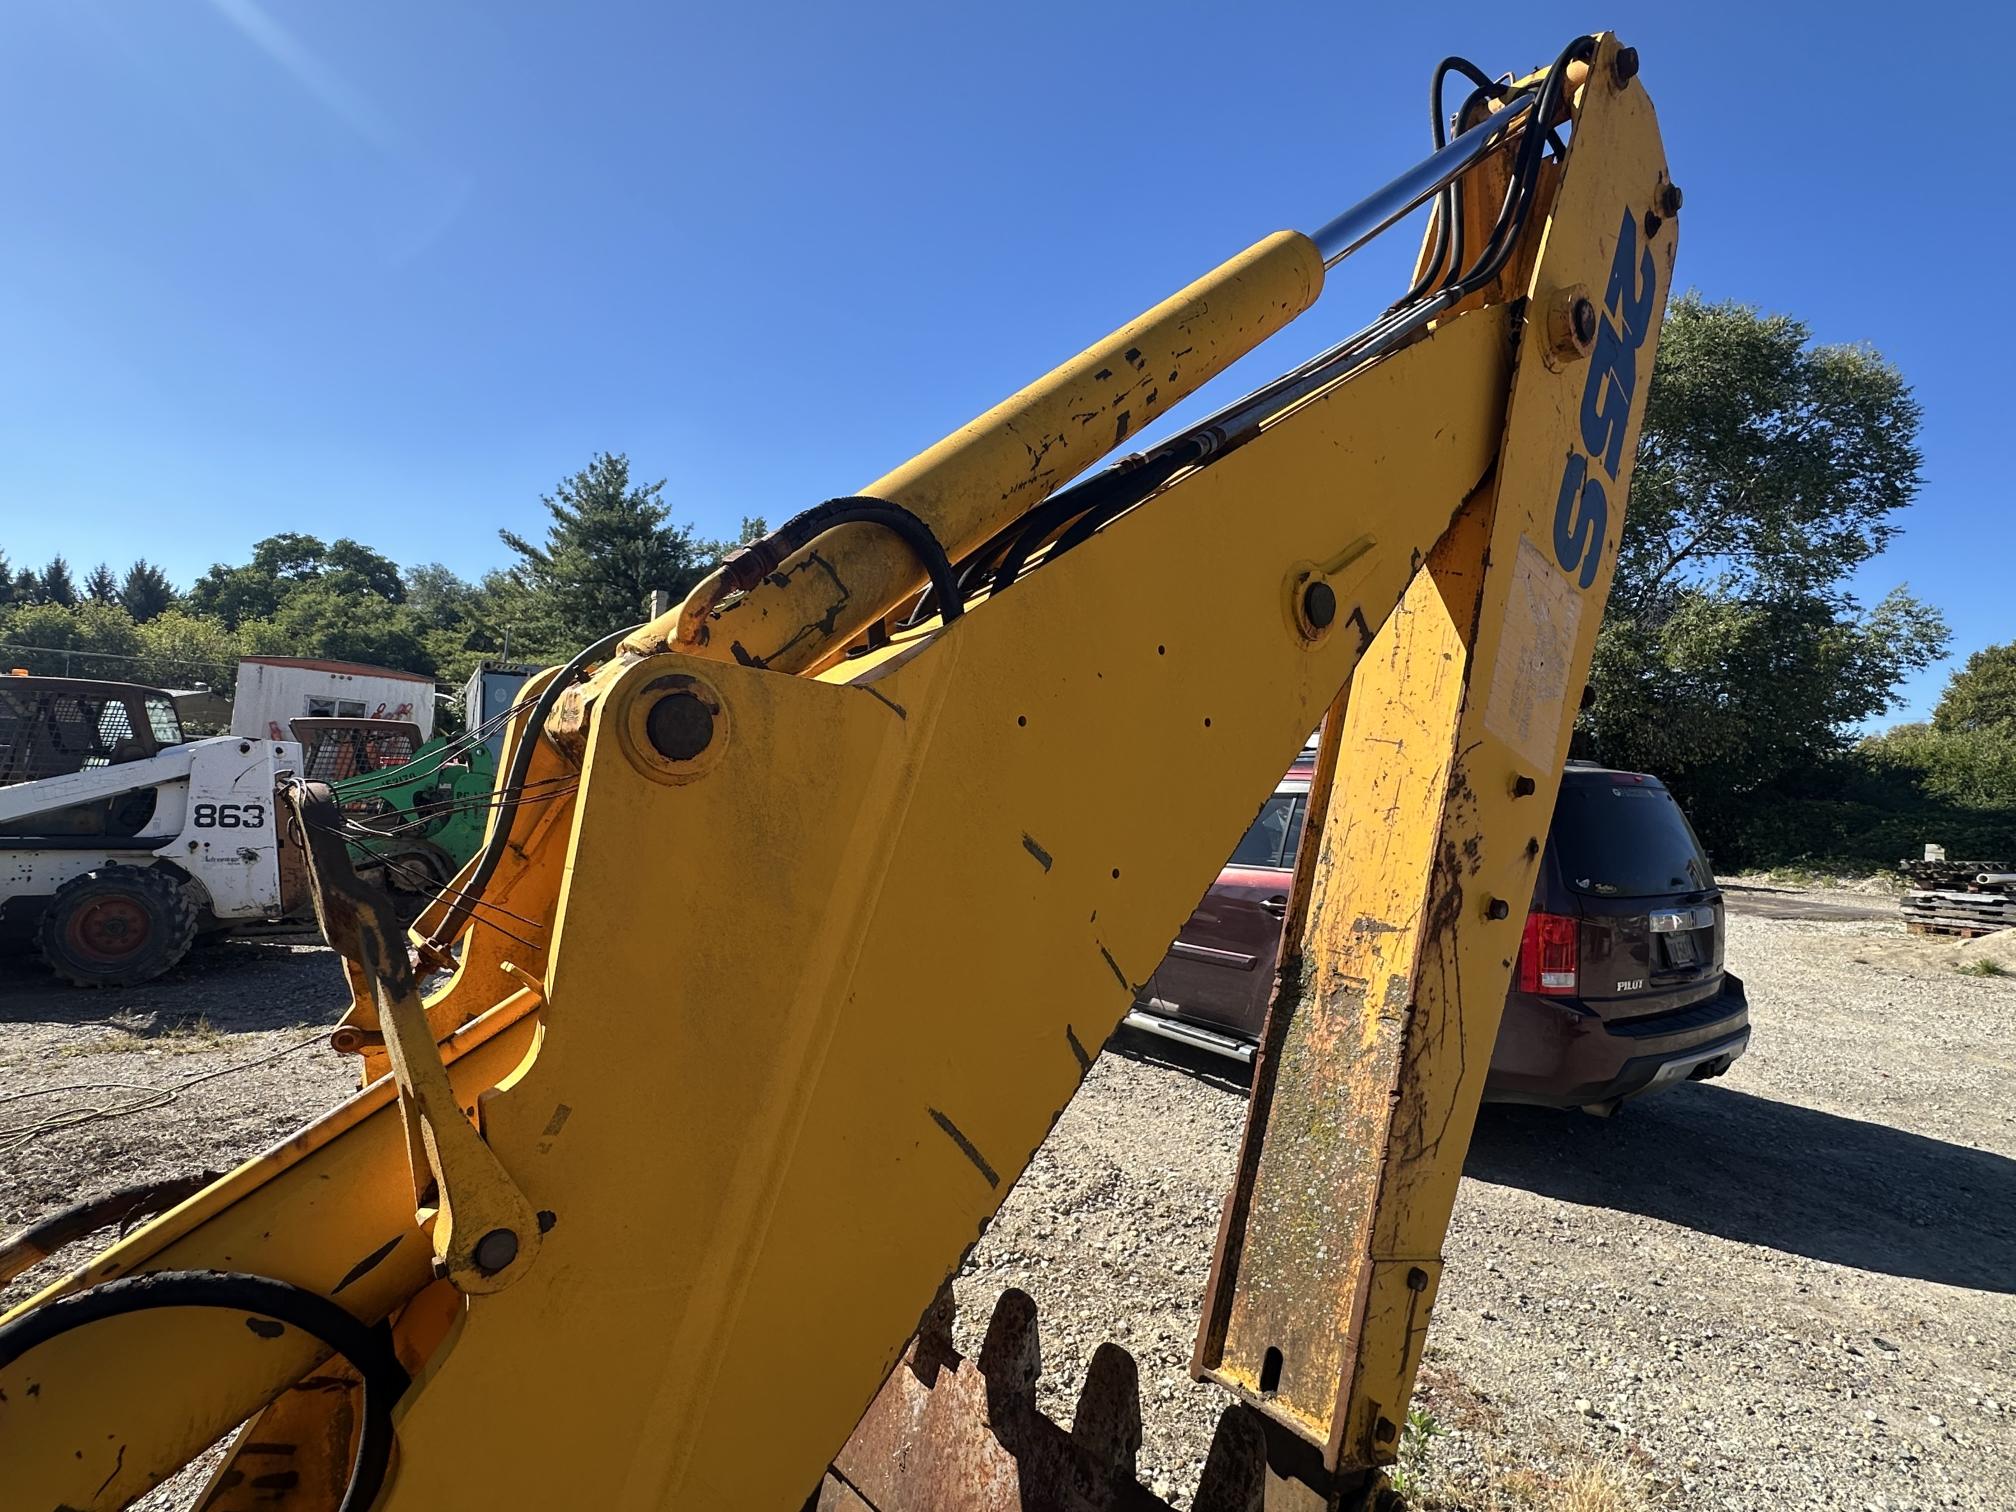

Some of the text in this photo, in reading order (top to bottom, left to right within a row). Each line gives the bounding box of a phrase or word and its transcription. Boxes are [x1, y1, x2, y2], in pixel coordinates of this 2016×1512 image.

[1554, 206, 1656, 589] 215S
[194, 804, 264, 828] 863
[1616, 979, 1643, 992] PILOT
